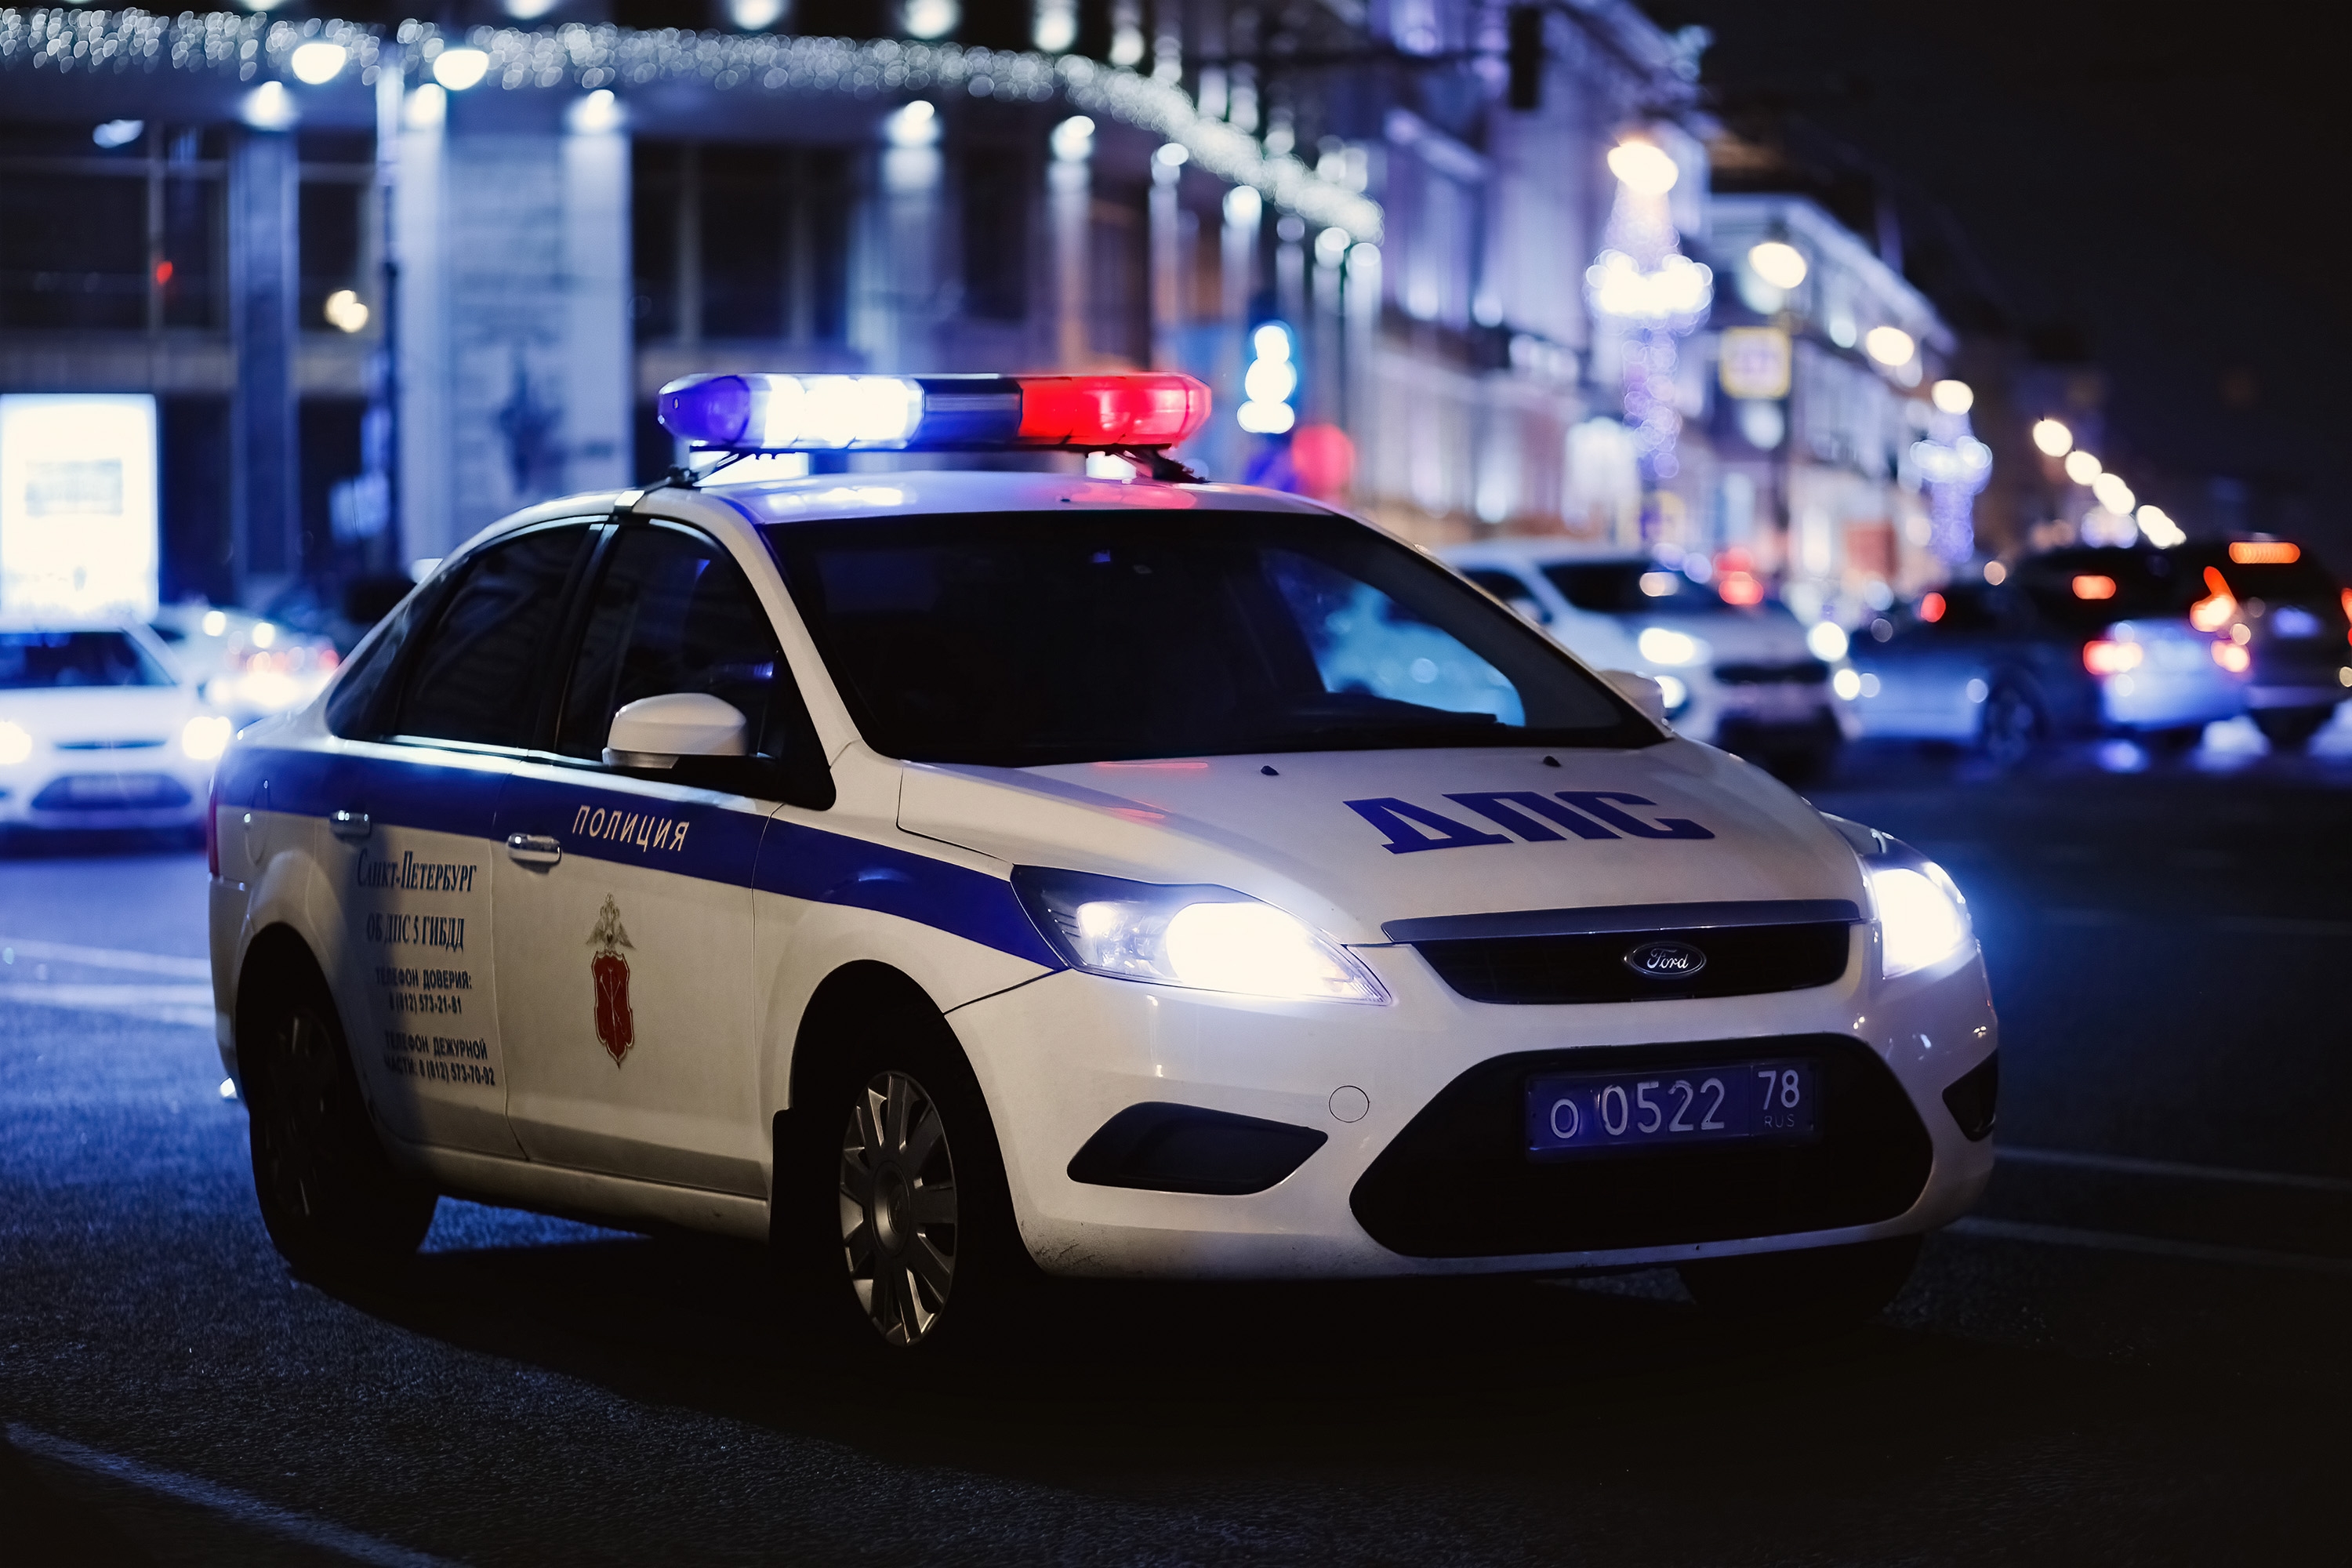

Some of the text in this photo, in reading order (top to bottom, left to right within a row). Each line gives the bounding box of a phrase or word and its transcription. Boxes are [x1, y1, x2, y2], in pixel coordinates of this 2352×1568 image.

[572, 804, 690, 852] ПОЛИЦИЯ
[1343, 791, 1715, 855] ДПС
[366, 913, 465, 952] ОБ ДПС 5 ГИБДД
[1646, 948, 1689, 969] Ford
[376, 966, 472, 990] ТЕЛЕФОН ДОВЕРИЯ:
[396, 993, 417, 1014] (812)
[385, 1029, 488, 1059] ТЕЛЕФОН ДЕЖУРНОЙ
[426, 1060, 449, 1083] (812)
[1600, 1077, 1725, 1136] 0522
[1758, 1069, 1800, 1111] 78
[1763, 1114, 1795, 1130] RUS
